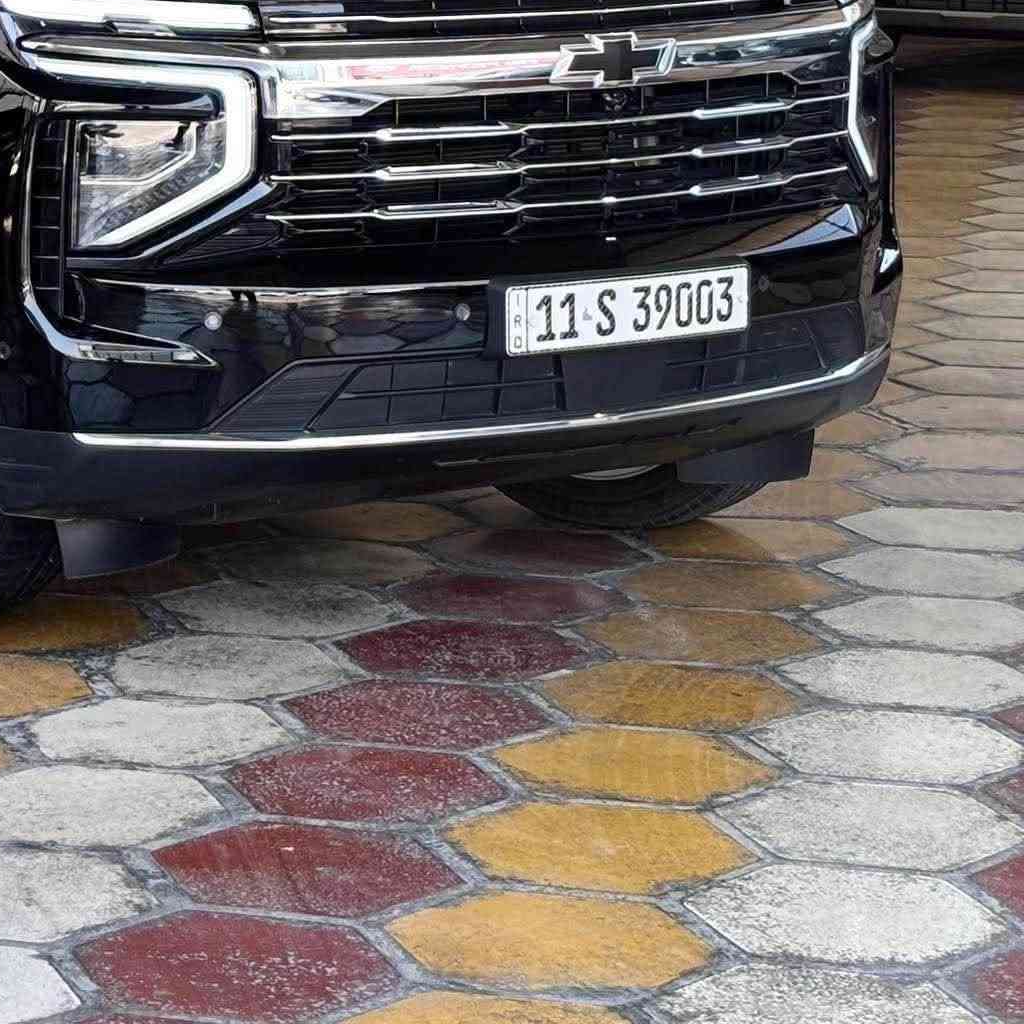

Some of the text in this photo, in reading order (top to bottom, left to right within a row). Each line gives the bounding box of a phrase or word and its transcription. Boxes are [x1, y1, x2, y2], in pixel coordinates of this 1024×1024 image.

[536, 276, 734, 342] 11 S 39003
